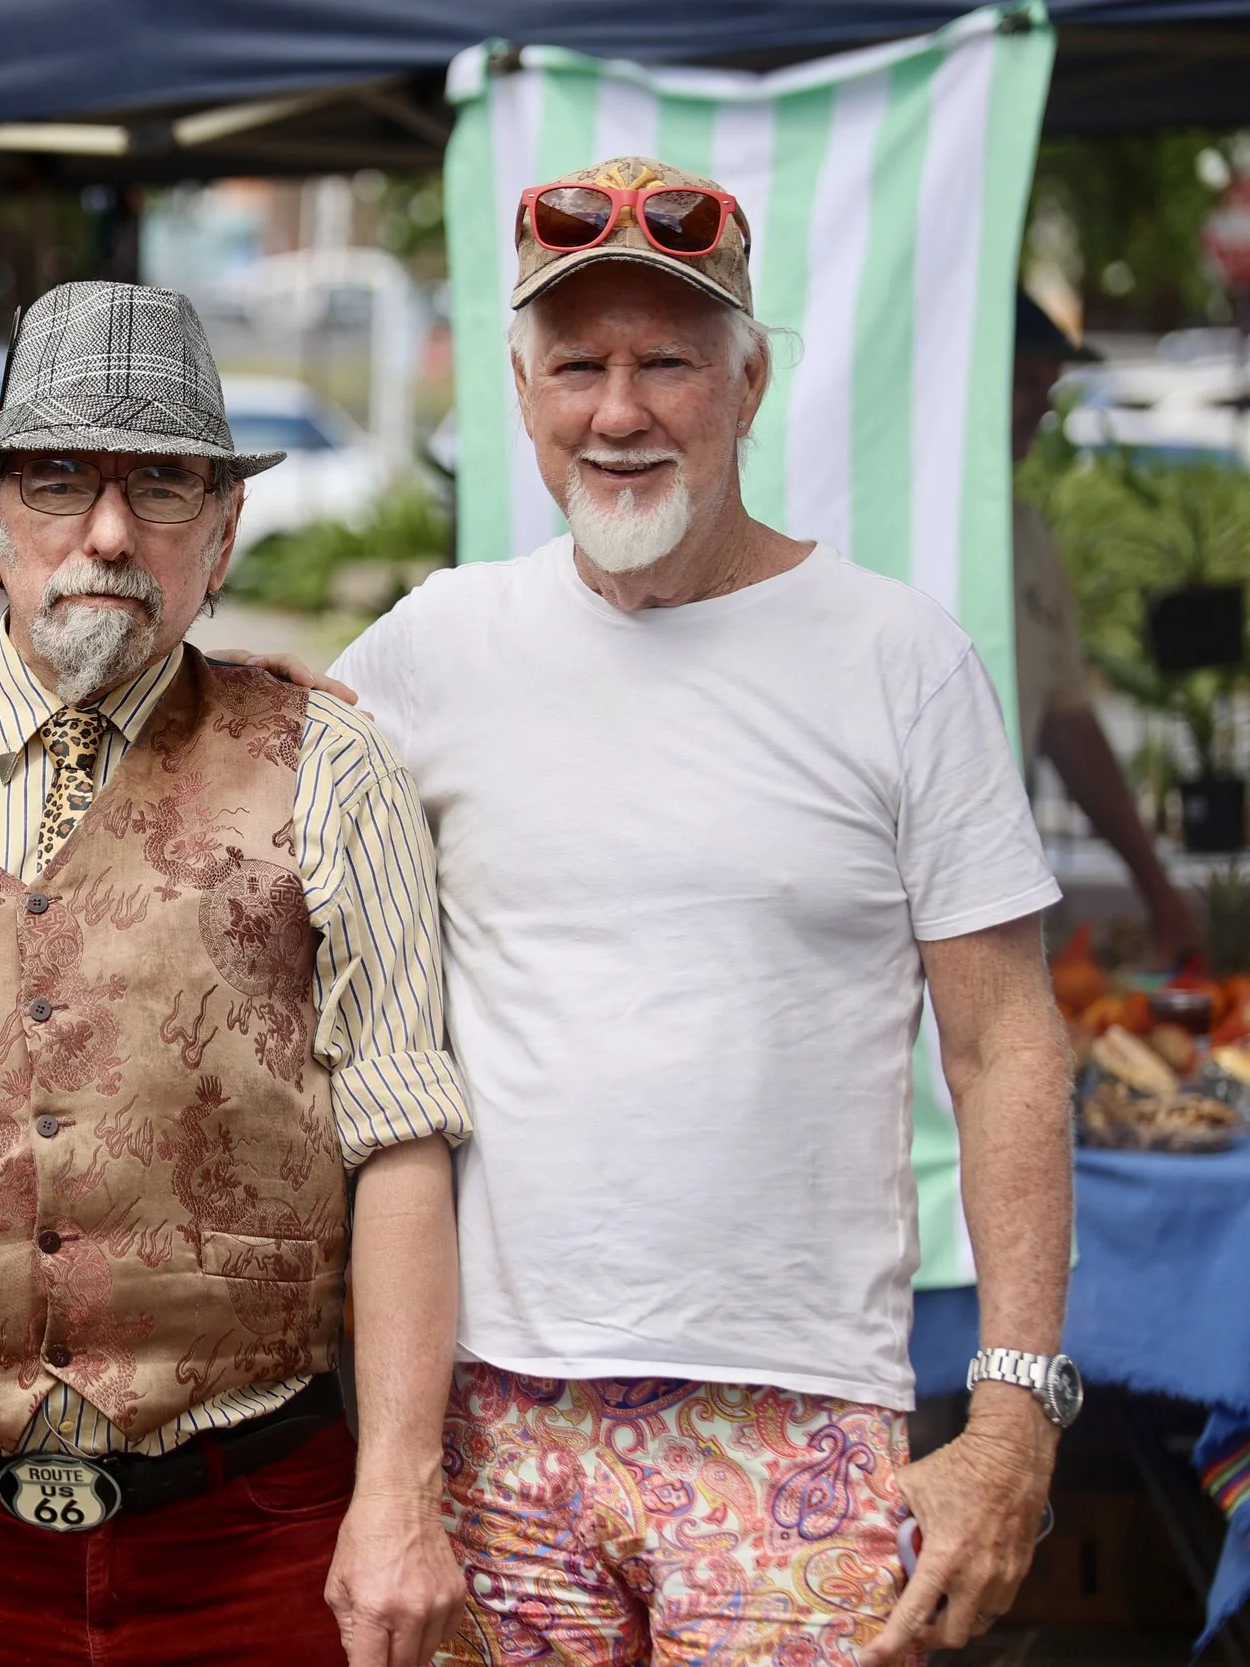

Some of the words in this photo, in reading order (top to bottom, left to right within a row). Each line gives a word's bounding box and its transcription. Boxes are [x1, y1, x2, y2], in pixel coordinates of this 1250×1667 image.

[28, 1467, 84, 1482] ROUTE
[40, 1485, 74, 1498] US
[34, 1498, 85, 1525] 66
